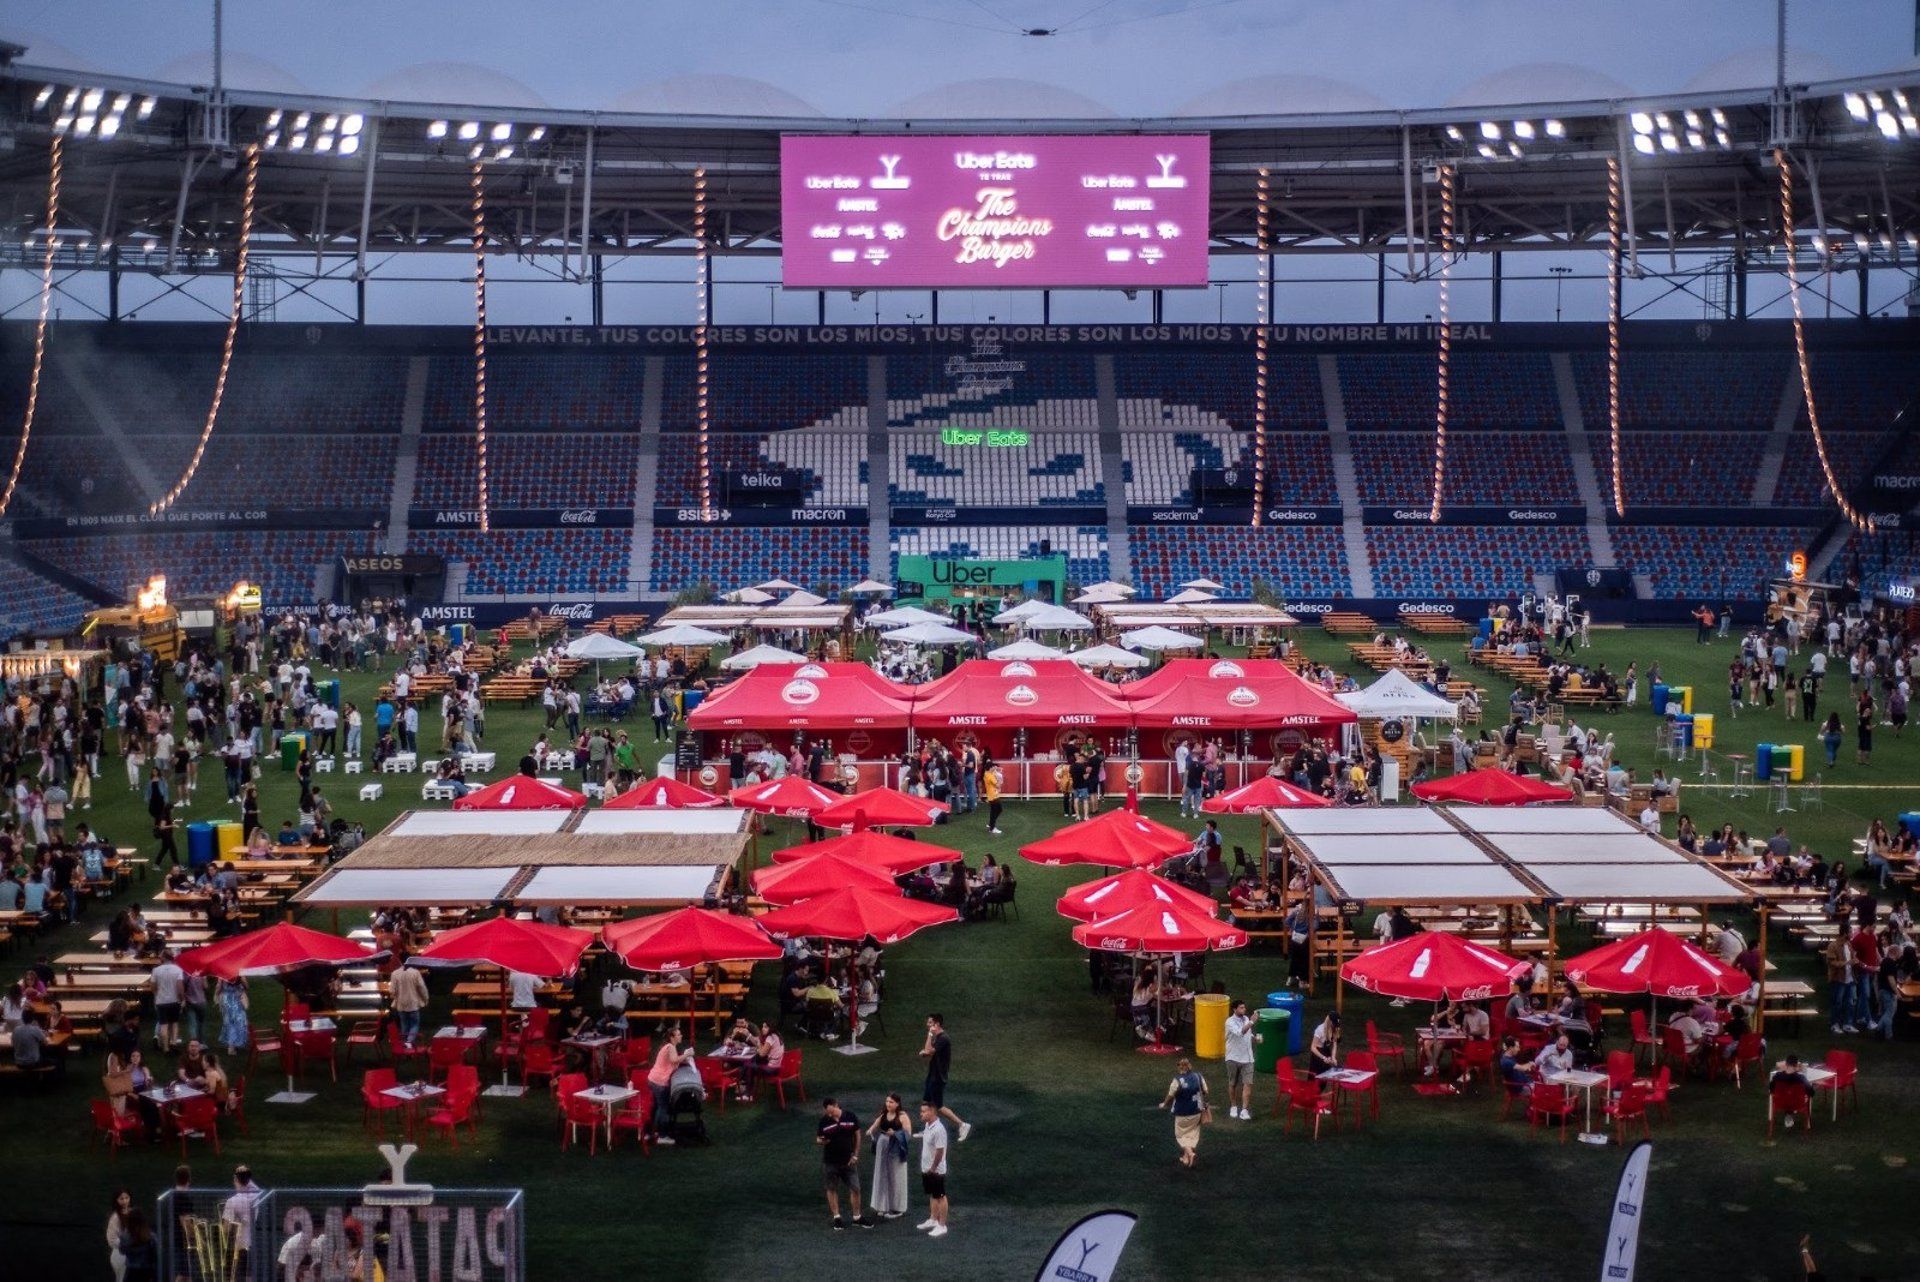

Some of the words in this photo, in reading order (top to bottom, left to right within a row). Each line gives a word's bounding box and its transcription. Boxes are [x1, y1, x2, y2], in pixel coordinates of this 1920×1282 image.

[955, 153, 994, 168] Uber
[996, 152, 1036, 168] Eats
[976, 187, 1017, 220] The
[938, 208, 1053, 241] Champions
[956, 236, 1036, 268] Burger
[486, 328, 592, 345] LEVANTE,
[598, 328, 639, 343] TUS
[754, 328, 799, 343] SON
[807, 328, 848, 343] LOS
[922, 327, 962, 342] TUS
[971, 327, 1071, 342] COLORES
[1078, 327, 1123, 342] SON
[1130, 327, 1171, 341] LOS
[1240, 327, 1253, 341] Y
[1296, 326, 1387, 341] NOMBRE
[1395, 326, 1418, 340] MI
[943, 429, 982, 445] Uber
[987, 431, 1028, 447] Eats
[741, 473, 782, 487] teika
[126, 514, 138, 523] EL
[167, 512, 189, 521] QUE
[191, 512, 226, 521] PORTE
[228, 512, 242, 520] AL
[244, 512, 268, 520] COR
[436, 511, 487, 523] AMSTE
[792, 509, 846, 520] macron
[1152, 509, 1199, 521] sesderma
[1268, 510, 1317, 520] Gedesco
[1393, 510, 1441, 520] Gedeso
[1508, 510, 1557, 520] Gedesco
[349, 558, 404, 570] ASEOS
[933, 561, 996, 583] Uber
[421, 606, 474, 619] AMSTEL
[1398, 602, 1454, 613] Gedesco
[948, 716, 987, 725] AMSTEL
[1058, 715, 1096, 724] AMSTEL
[1172, 716, 1211, 725] AMSTEL
[1281, 715, 1320, 724] AMSTEL
